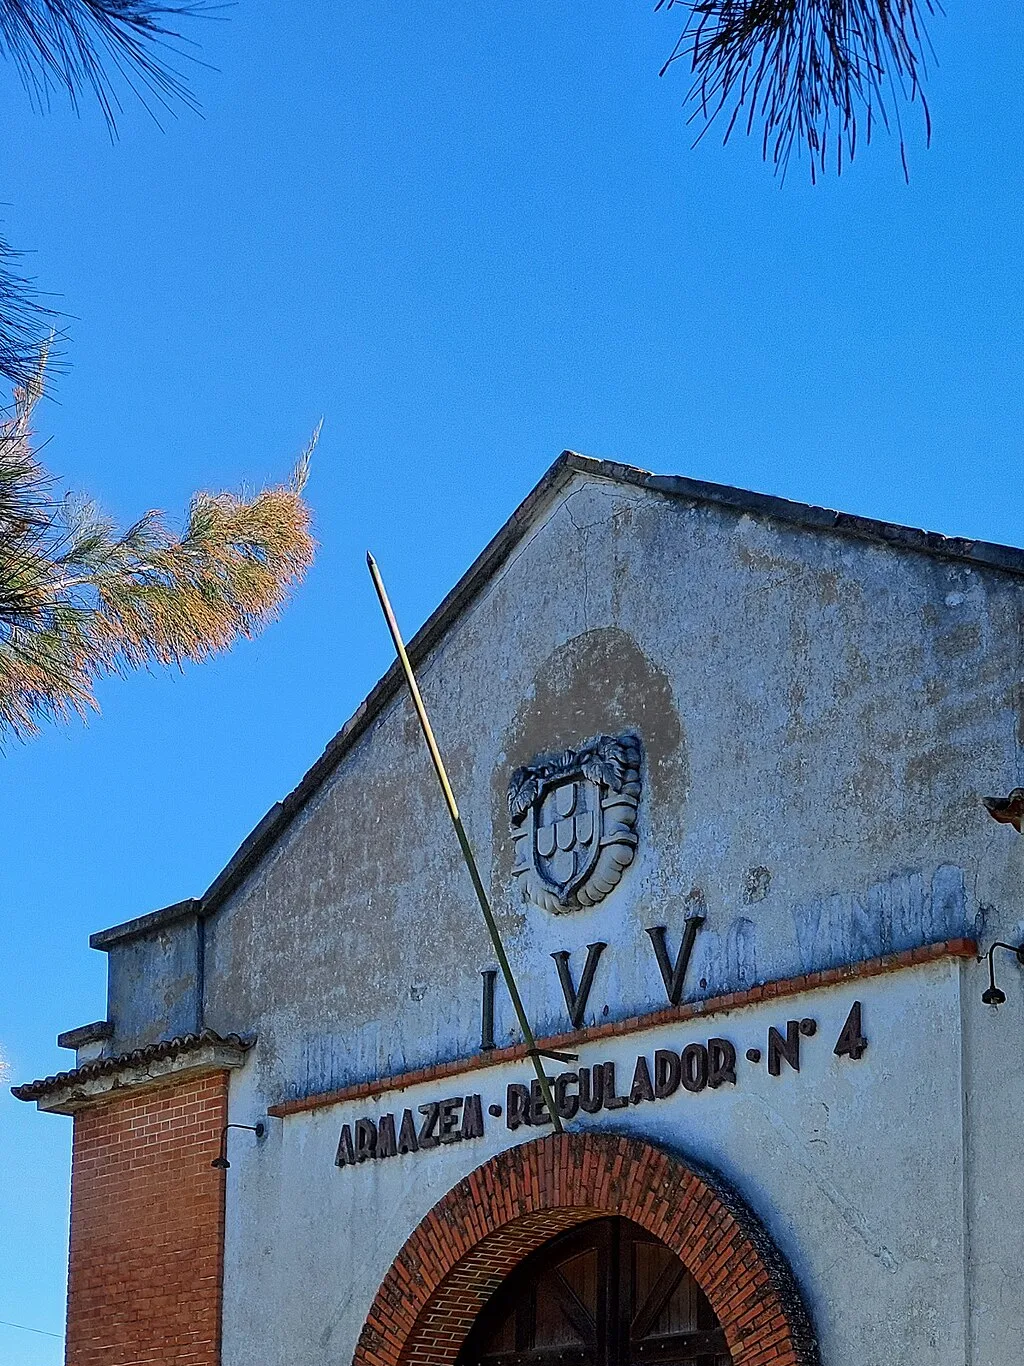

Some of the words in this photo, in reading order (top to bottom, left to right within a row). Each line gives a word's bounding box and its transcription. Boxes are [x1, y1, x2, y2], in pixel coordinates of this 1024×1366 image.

[334, 1093, 485, 1168] ARMAZEM
[506, 1037, 737, 1131] REGULADOR
[833, 1000, 868, 1060] 4
